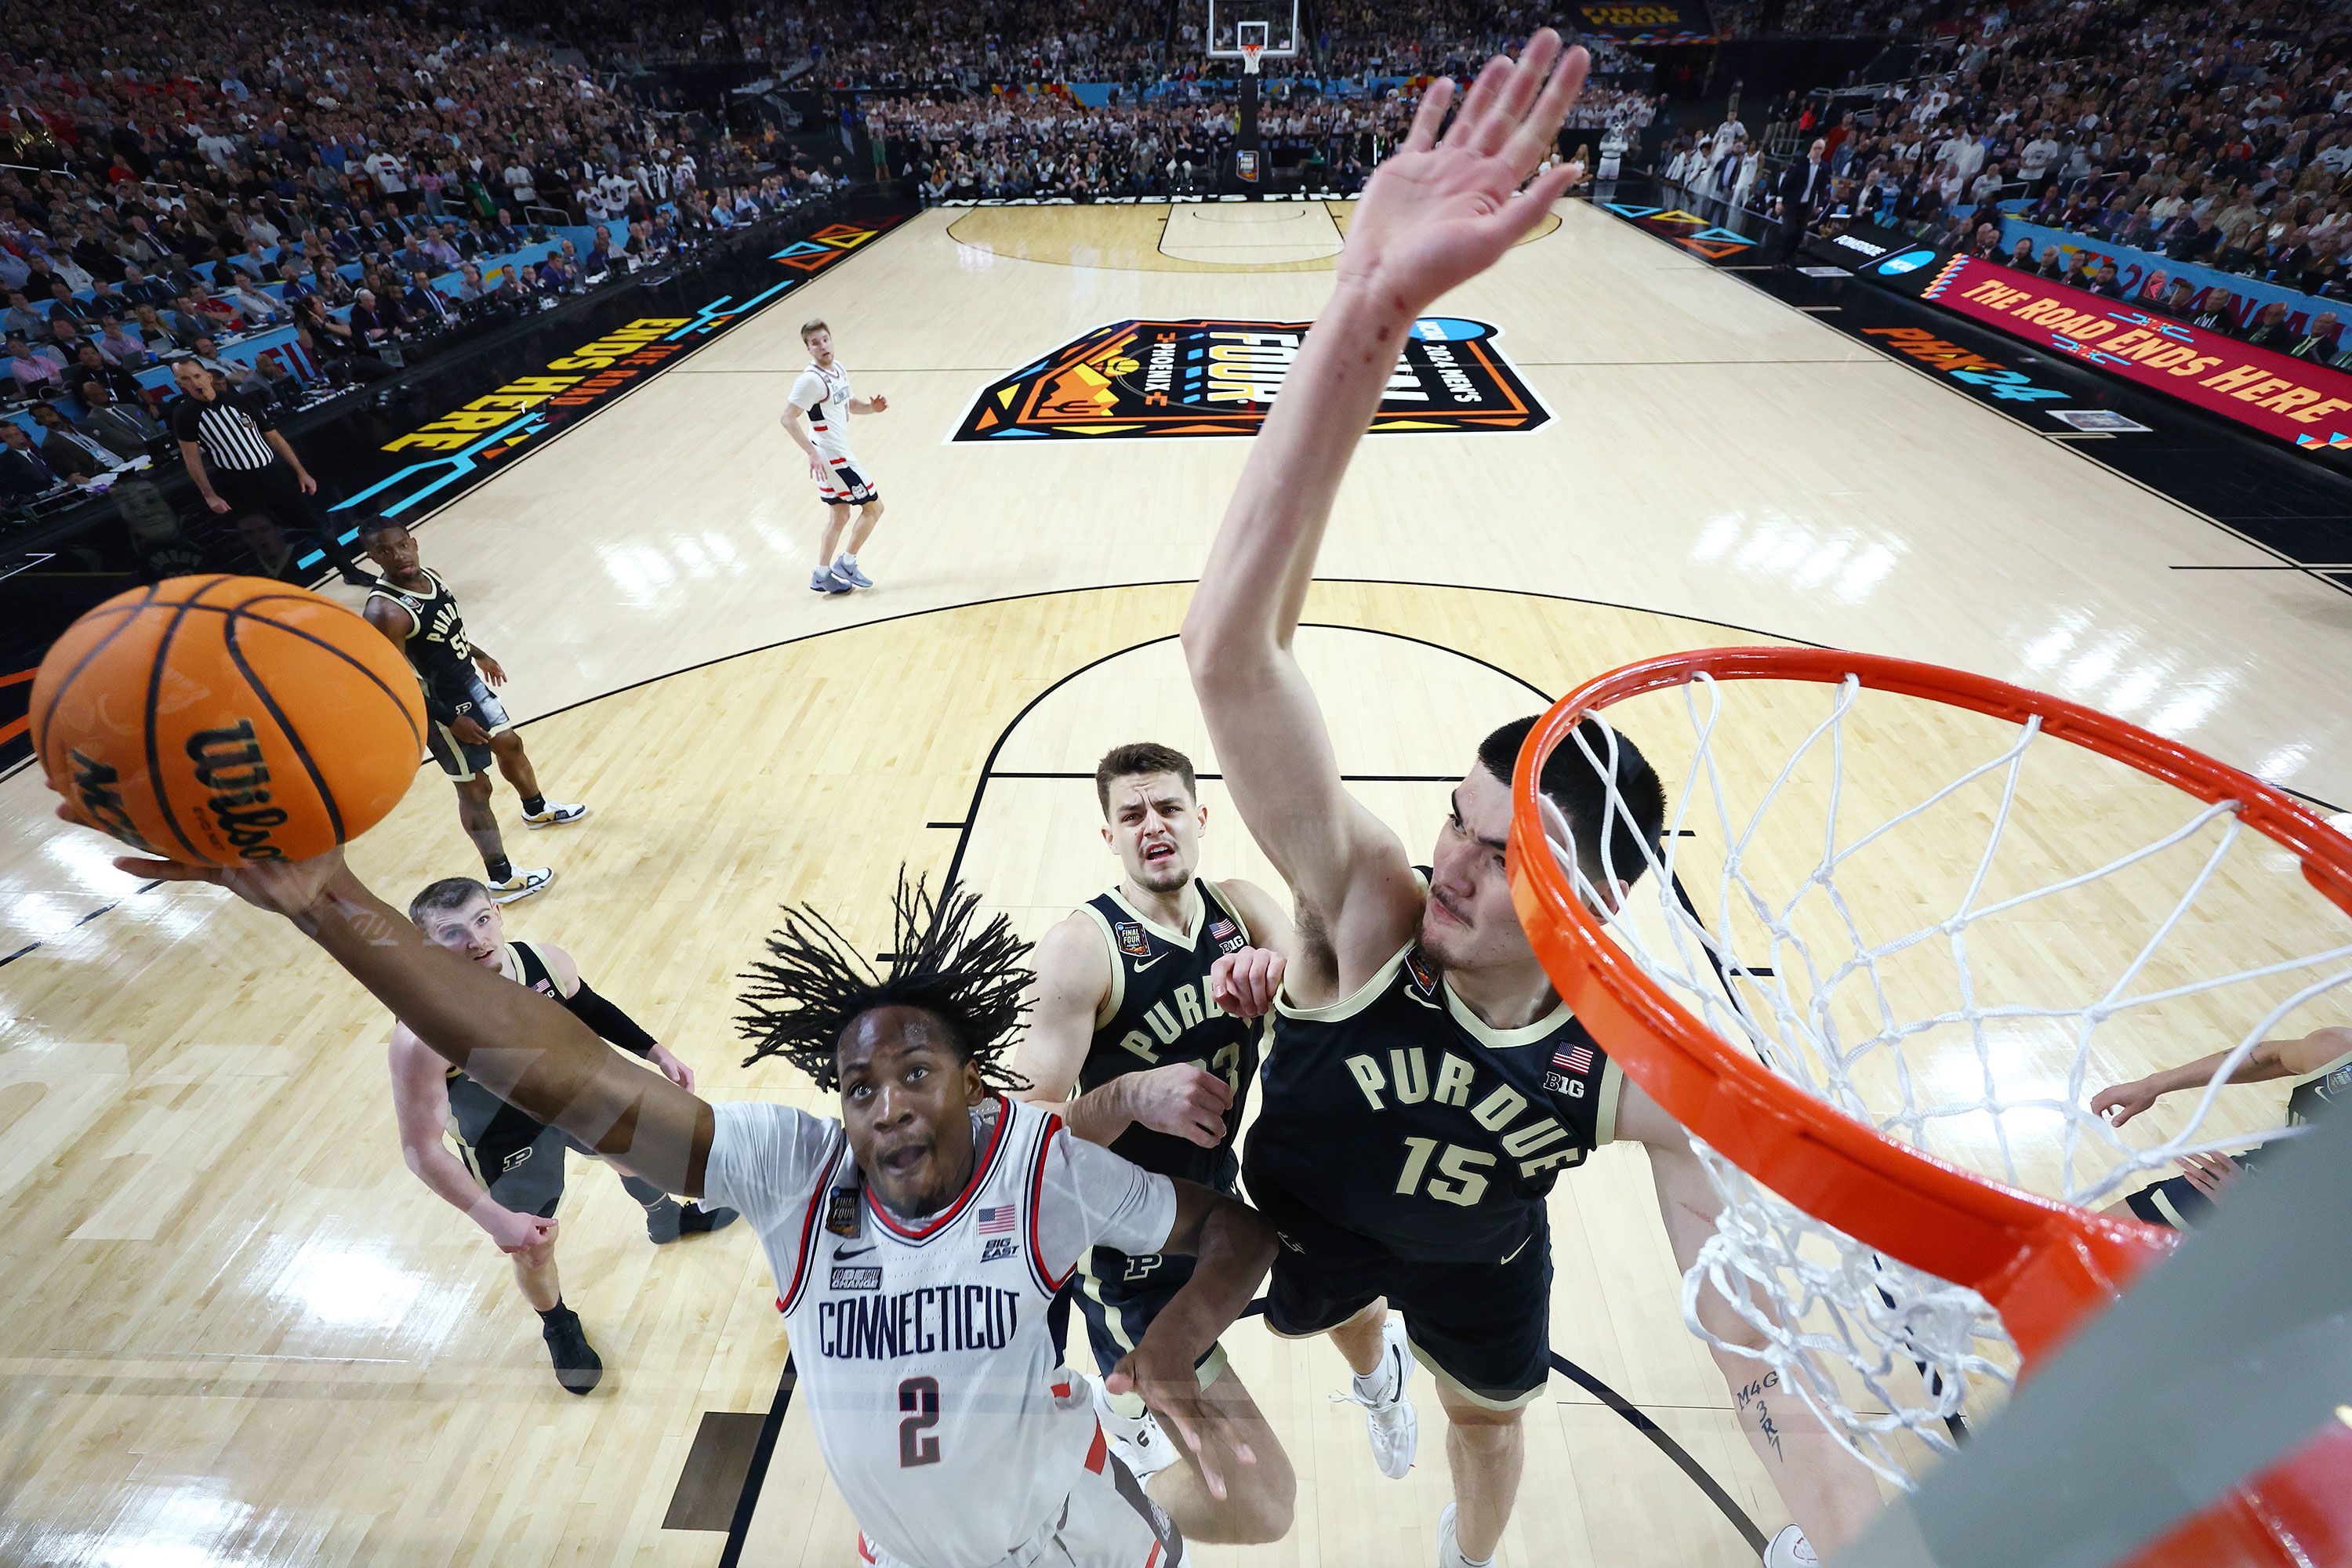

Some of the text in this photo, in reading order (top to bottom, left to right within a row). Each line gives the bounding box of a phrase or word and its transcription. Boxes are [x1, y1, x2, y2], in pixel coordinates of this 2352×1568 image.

[942, 198, 1076, 207] NCAA
[1094, 194, 1247, 205] MEN'S
[549, 343, 684, 405] THE ROAD
[1145, 343, 1176, 392] PHOENIX
[1423, 345, 1483, 403] 2024 MEN'S
[1961, 279, 2352, 423] THE ROAD ENDS HERE
[380, 318, 693, 452] ENDS HERE
[1122, 928, 1140, 938] FINAL
[1123, 935, 1141, 944] FOUR
[1343, 1047, 1581, 1179] PURDUE
[1395, 1136, 1497, 1207] 15
[982, 1245, 1020, 1260] EAST
[985, 1237, 1011, 1248] BIG
[818, 1284, 1020, 1361] CONNECTICUT
[898, 1375, 941, 1468] 2
